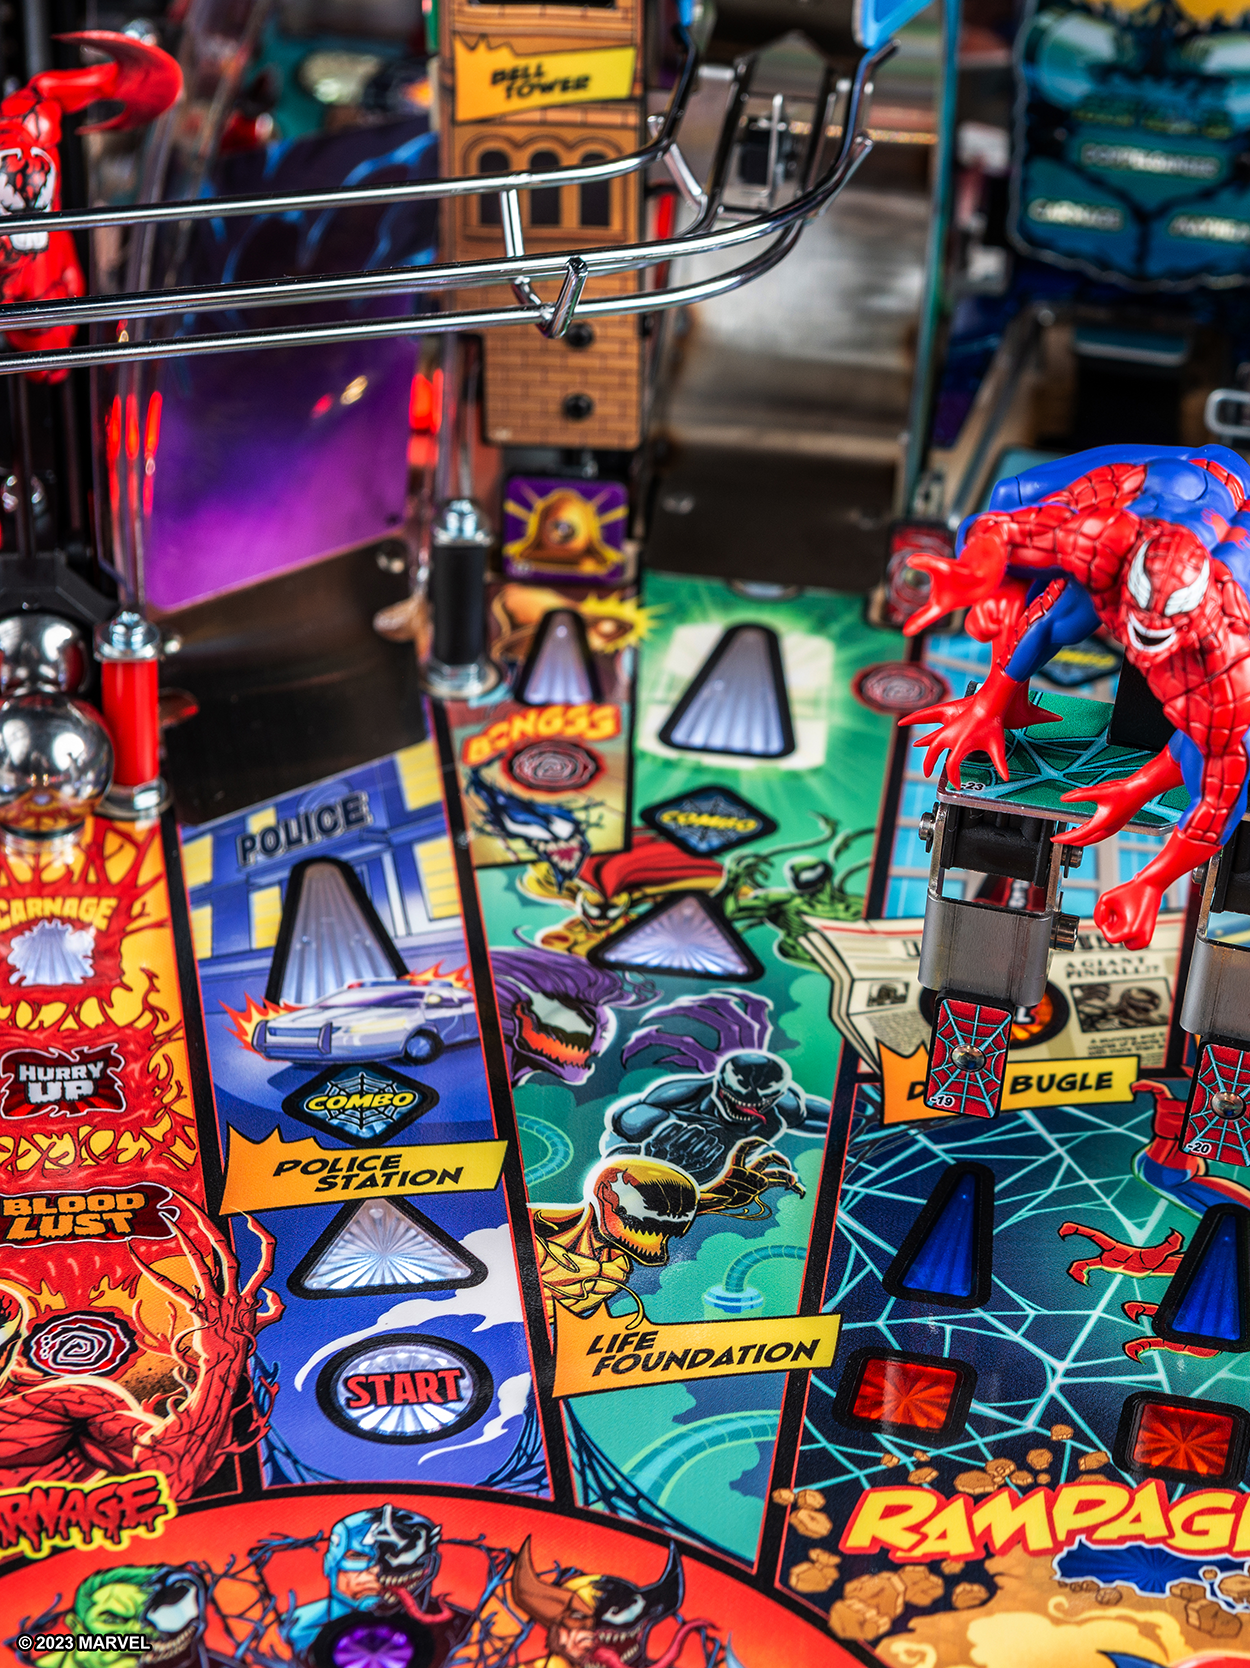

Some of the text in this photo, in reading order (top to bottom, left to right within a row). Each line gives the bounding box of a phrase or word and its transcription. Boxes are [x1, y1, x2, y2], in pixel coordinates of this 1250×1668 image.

[491, 63, 544, 86] BELL
[505, 75, 591, 100] TOWER
[239, 795, 368, 867] POLICE
[661, 811, 758, 833] COMBO
[19, 1061, 104, 1081] HURRY
[1009, 1071, 1114, 1095] BUGLE
[28, 1080, 95, 1104] UP
[308, 1092, 415, 1111] COMBO
[930, 1095, 954, 1106] -19
[1187, 1142, 1210, 1154] -20
[273, 1154, 402, 1177] POLICE
[314, 1166, 464, 1193] STATION
[3, 1192, 146, 1216] BLOOD
[6, 1211, 134, 1240] LUST
[586, 1331, 659, 1356] LIFE
[592, 1339, 821, 1378] FOUNDATION
[346, 1369, 461, 1408] START
[0, 1476, 169, 1553] RNAGE
